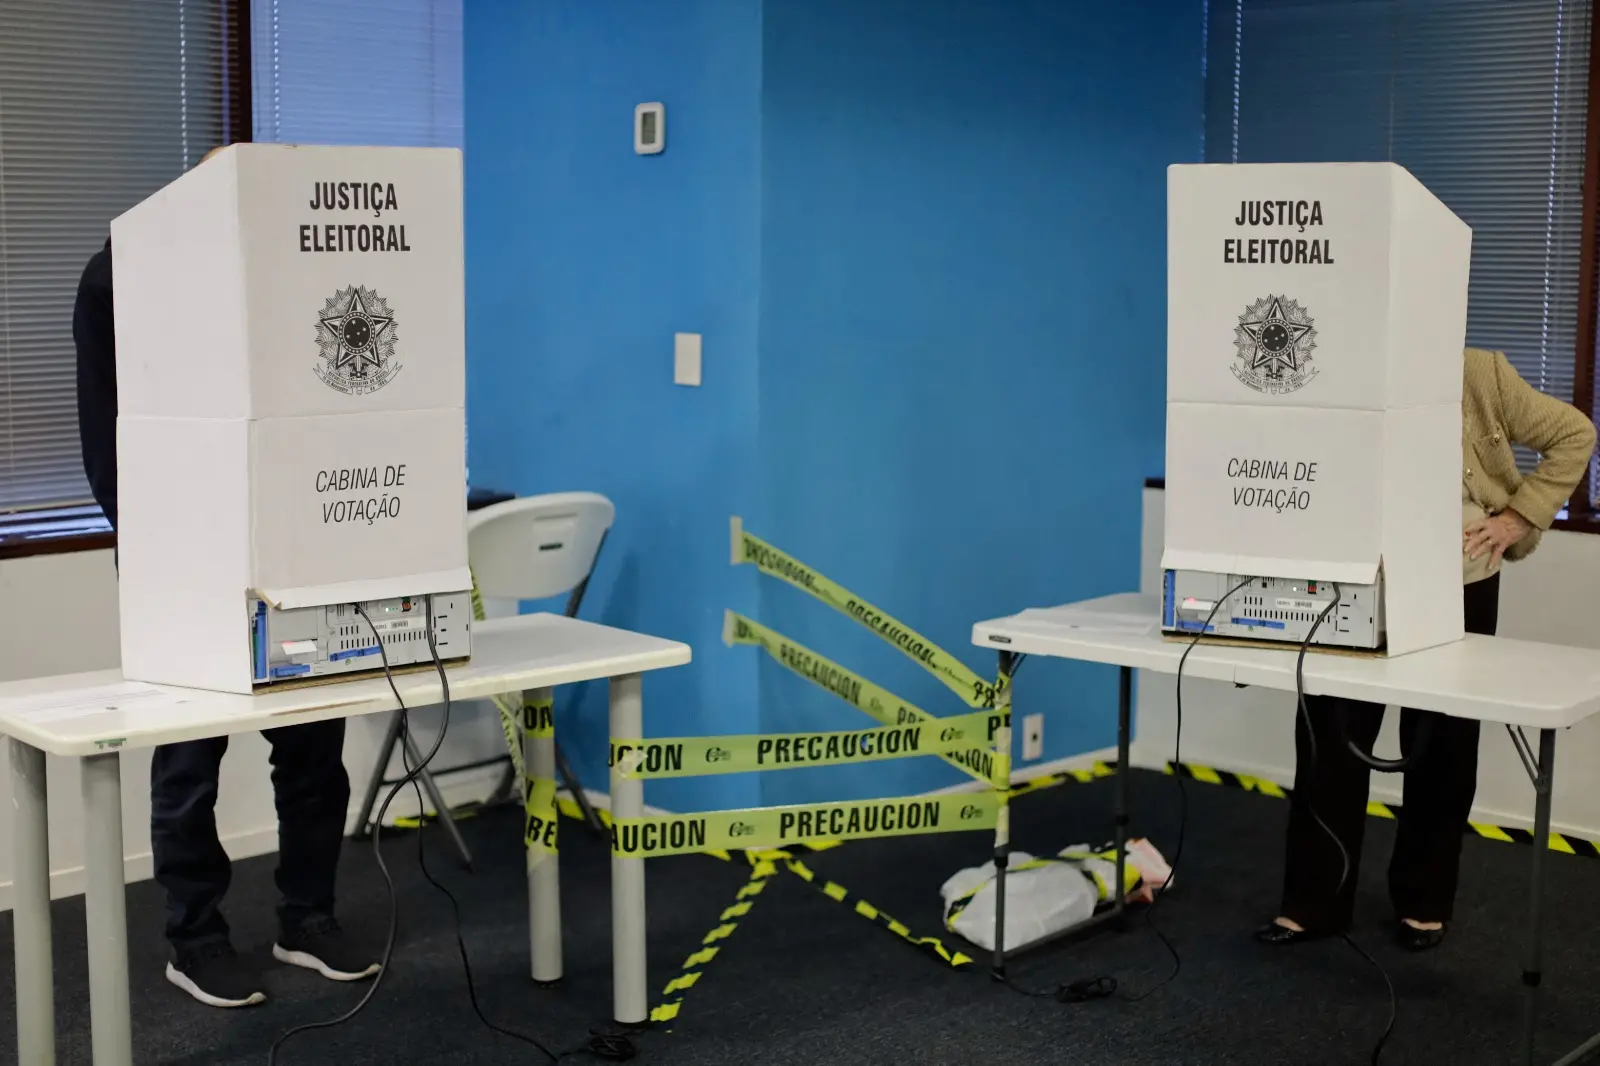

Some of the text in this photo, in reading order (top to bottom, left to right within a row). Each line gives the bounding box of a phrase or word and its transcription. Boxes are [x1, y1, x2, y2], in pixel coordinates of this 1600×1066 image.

[309, 181, 398, 217] JUSTIÇA
[1235, 200, 1323, 232] JUSTIÇA
[299, 224, 411, 252] ELEITORAL
[1223, 238, 1335, 264] ELEITORAL
[315, 464, 407, 493] CABINA DE
[1227, 458, 1318, 482] CABINA DE
[322, 493, 400, 525] VOTAÇÃO
[1233, 487, 1310, 513] VOTAÇÃO
[756, 727, 922, 765] PRECAUCION
[779, 801, 941, 839] PRECAUCION
